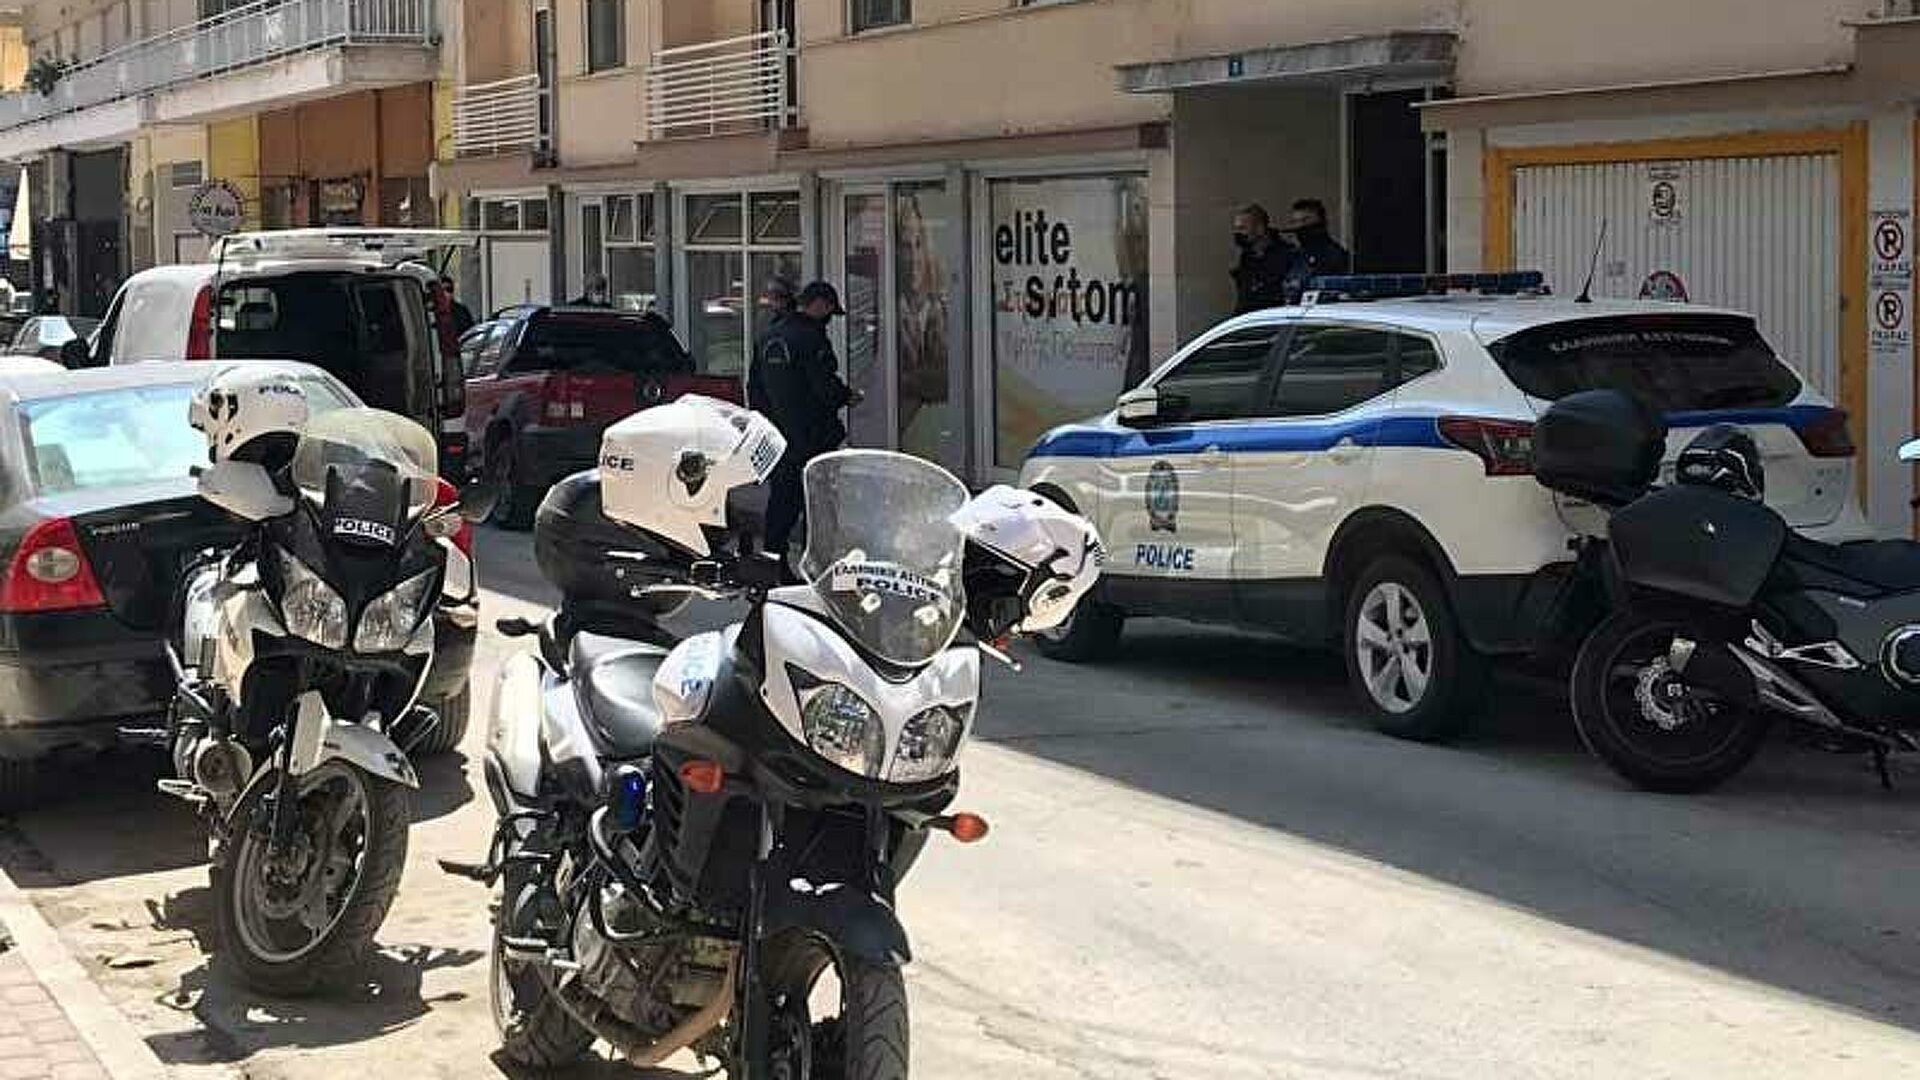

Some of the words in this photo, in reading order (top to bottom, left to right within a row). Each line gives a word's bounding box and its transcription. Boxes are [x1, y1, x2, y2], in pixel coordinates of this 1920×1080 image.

[995, 209, 1070, 266] elite
[334, 518, 395, 544] POLICE
[1136, 543, 1195, 570] POLICE
[857, 577, 938, 601] POLICE
